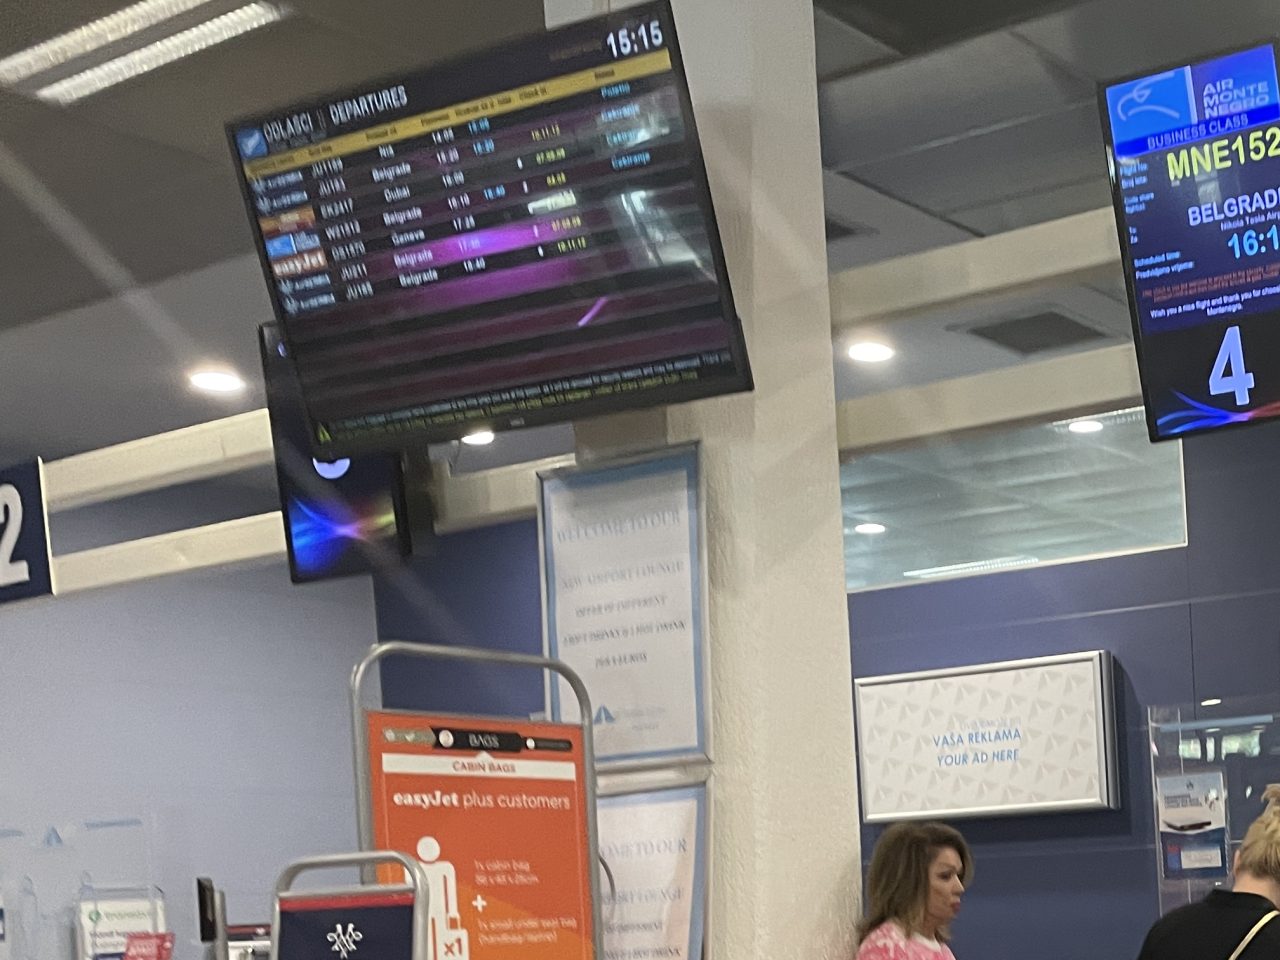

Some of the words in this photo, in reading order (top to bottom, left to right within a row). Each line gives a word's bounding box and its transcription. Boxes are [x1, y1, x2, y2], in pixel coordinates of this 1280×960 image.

[606, 20, 663, 58] 15:15
[1203, 78, 1233, 95] AIR
[1203, 81, 1269, 109] MONTE
[263, 111, 313, 144] ODLASCI
[329, 85, 407, 125] DEPARTURES
[1204, 94, 1269, 119] NEGRO
[1147, 124, 1206, 149] BUSINESS
[1209, 114, 1249, 134] CLASS
[1221, 219, 1244, 231] Nikola
[1246, 214, 1265, 225] Tesla
[1150, 308, 1165, 318] Wish
[1166, 307, 1177, 317] you
[1241, 291, 1252, 301] you
[1208, 325, 1255, 406] 4
[469, 733, 499, 748] BAGS
[933, 732, 964, 748] VAŠA
[967, 727, 1021, 745] REKLAMA
[452, 761, 485, 773] CABIN
[489, 763, 516, 774] BAGS
[936, 753, 968, 767] YOUR
[971, 751, 989, 765] AD
[992, 748, 1019, 763] HERE
[393, 790, 458, 809] easyJet
[462, 790, 494, 810] plus
[497, 793, 570, 810] customers
[444, 938, 463, 957] x1
